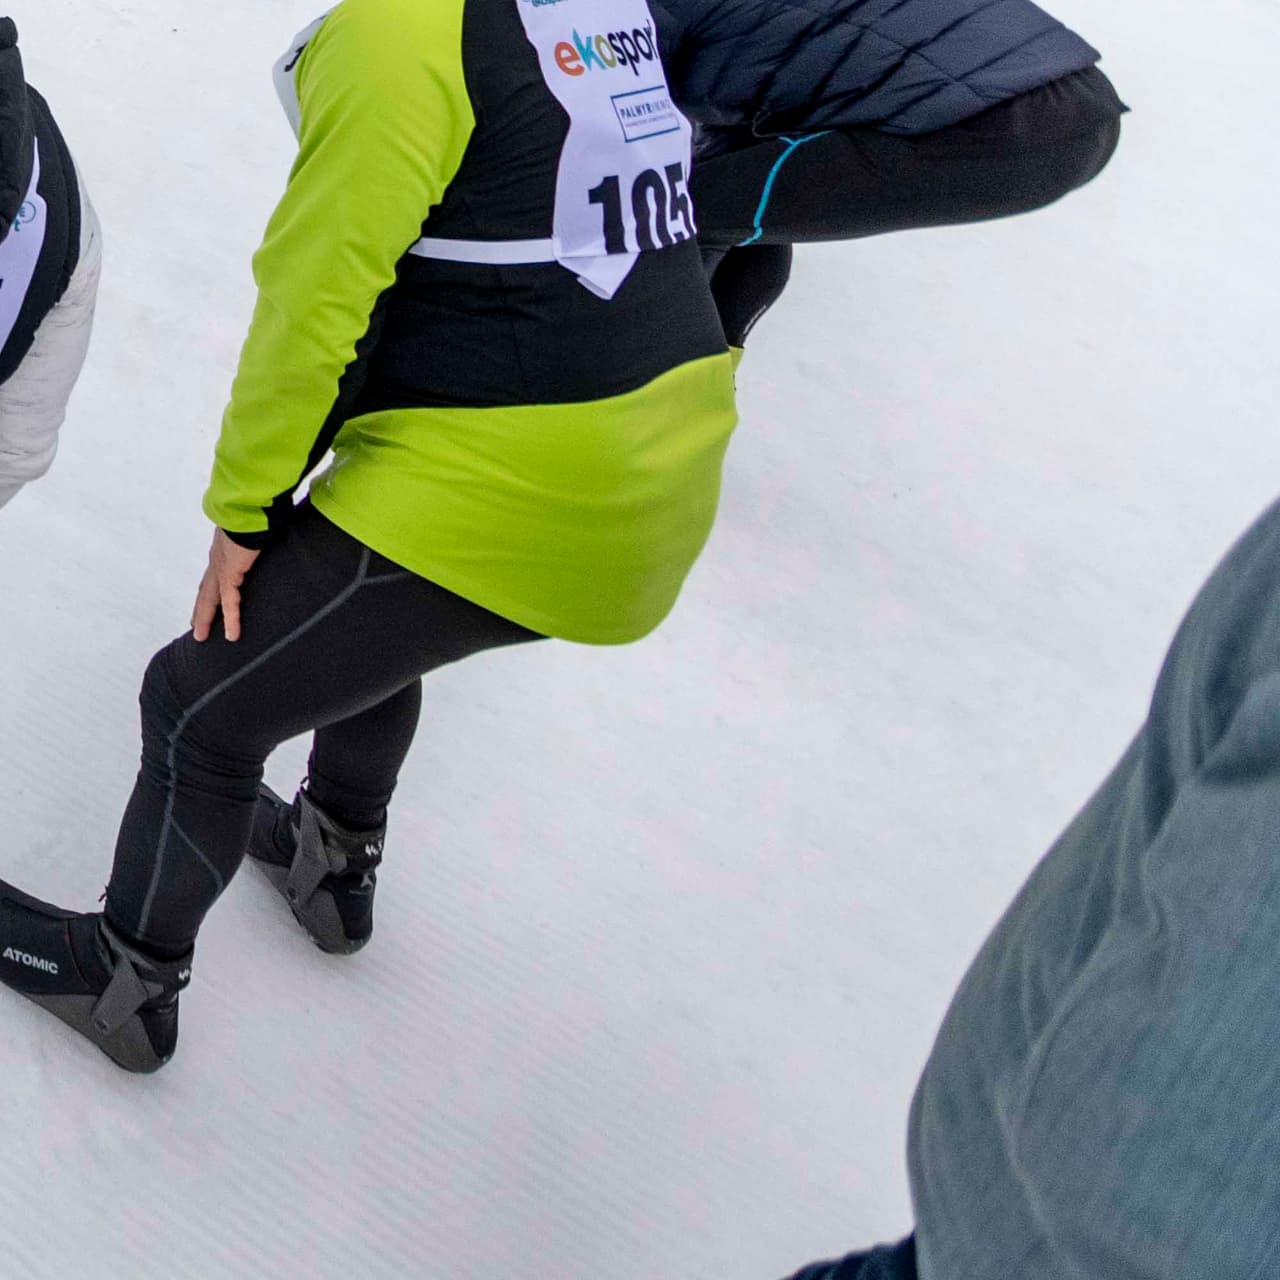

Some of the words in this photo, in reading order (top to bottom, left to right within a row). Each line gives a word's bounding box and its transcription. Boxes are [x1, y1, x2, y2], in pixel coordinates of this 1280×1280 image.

[553, 18, 659, 77] ekospor
[587, 160, 697, 255] 105
[2, 946, 60, 975] ATOMIC
